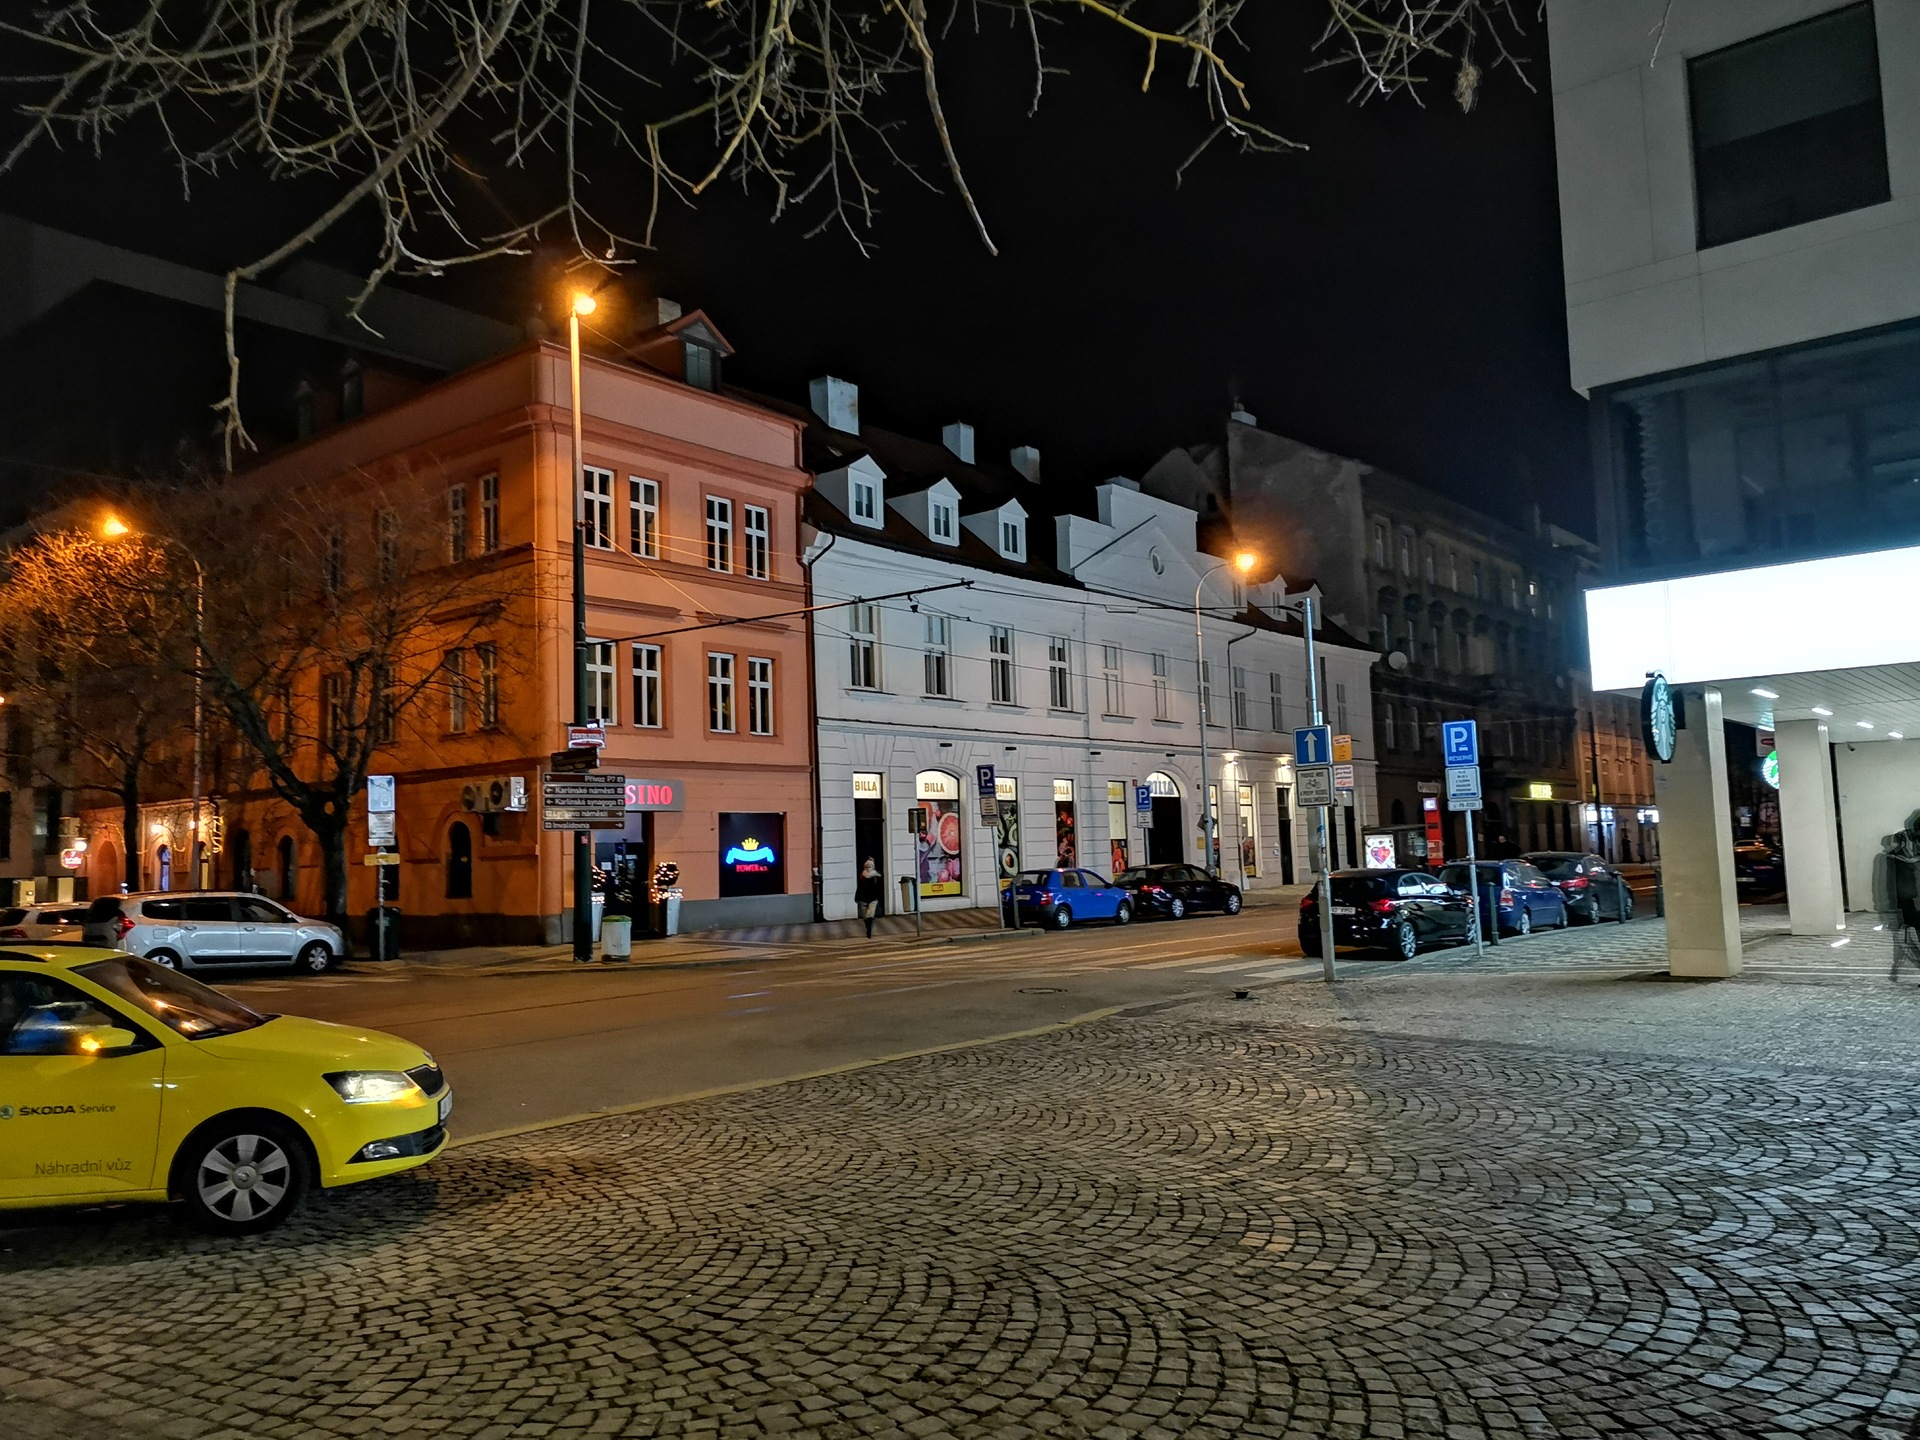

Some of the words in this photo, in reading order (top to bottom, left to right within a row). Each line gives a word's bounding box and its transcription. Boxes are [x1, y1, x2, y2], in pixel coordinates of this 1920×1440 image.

[1450, 727, 1468, 753] P
[855, 781, 877, 791] BILLA
[924, 782, 945, 793] BILLA
[995, 784, 1013, 794] BILLA
[19, 1105, 76, 1116] ŠKODA
[79, 1104, 116, 1114] Service
[34, 1159, 103, 1175] Náhradní
[107, 1157, 132, 1171] vůz
